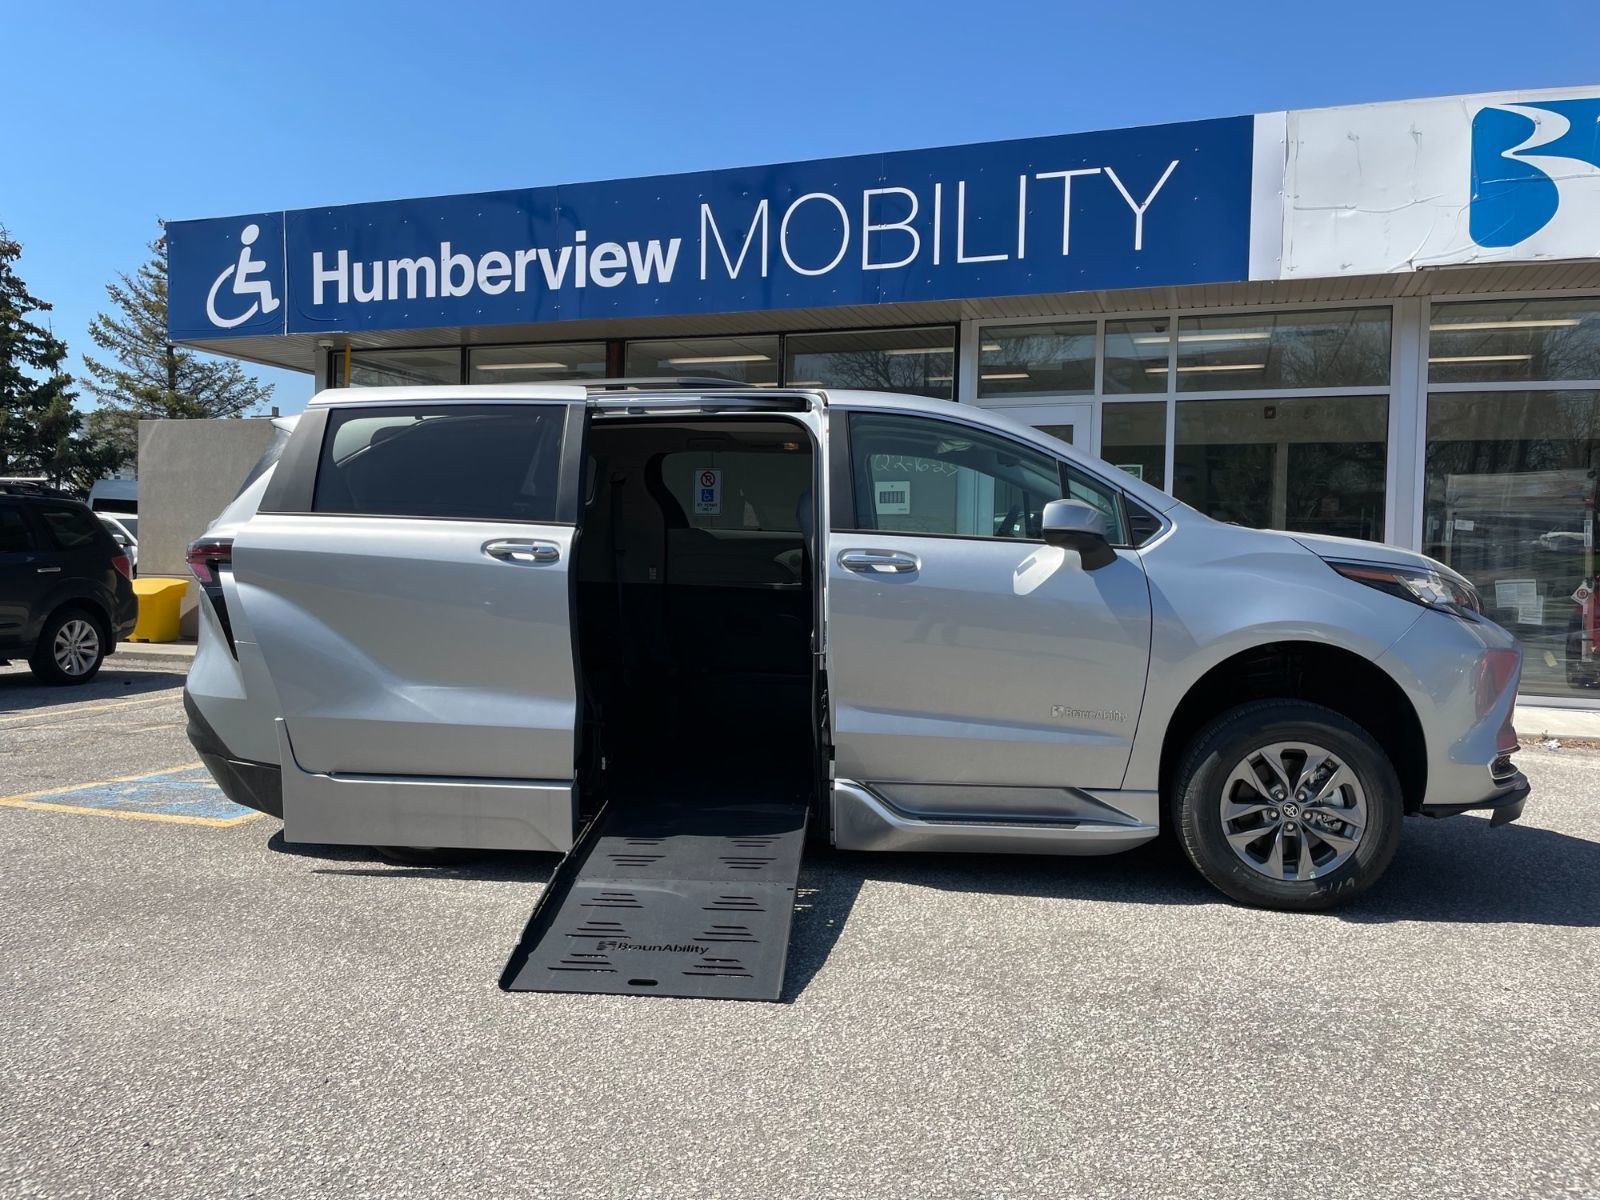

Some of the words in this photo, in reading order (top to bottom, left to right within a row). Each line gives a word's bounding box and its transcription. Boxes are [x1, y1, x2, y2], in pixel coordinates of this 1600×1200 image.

[312, 229, 682, 306] Humberview
[699, 160, 1179, 280] MOBILITY
[617, 942, 710, 955] BraunAbility
